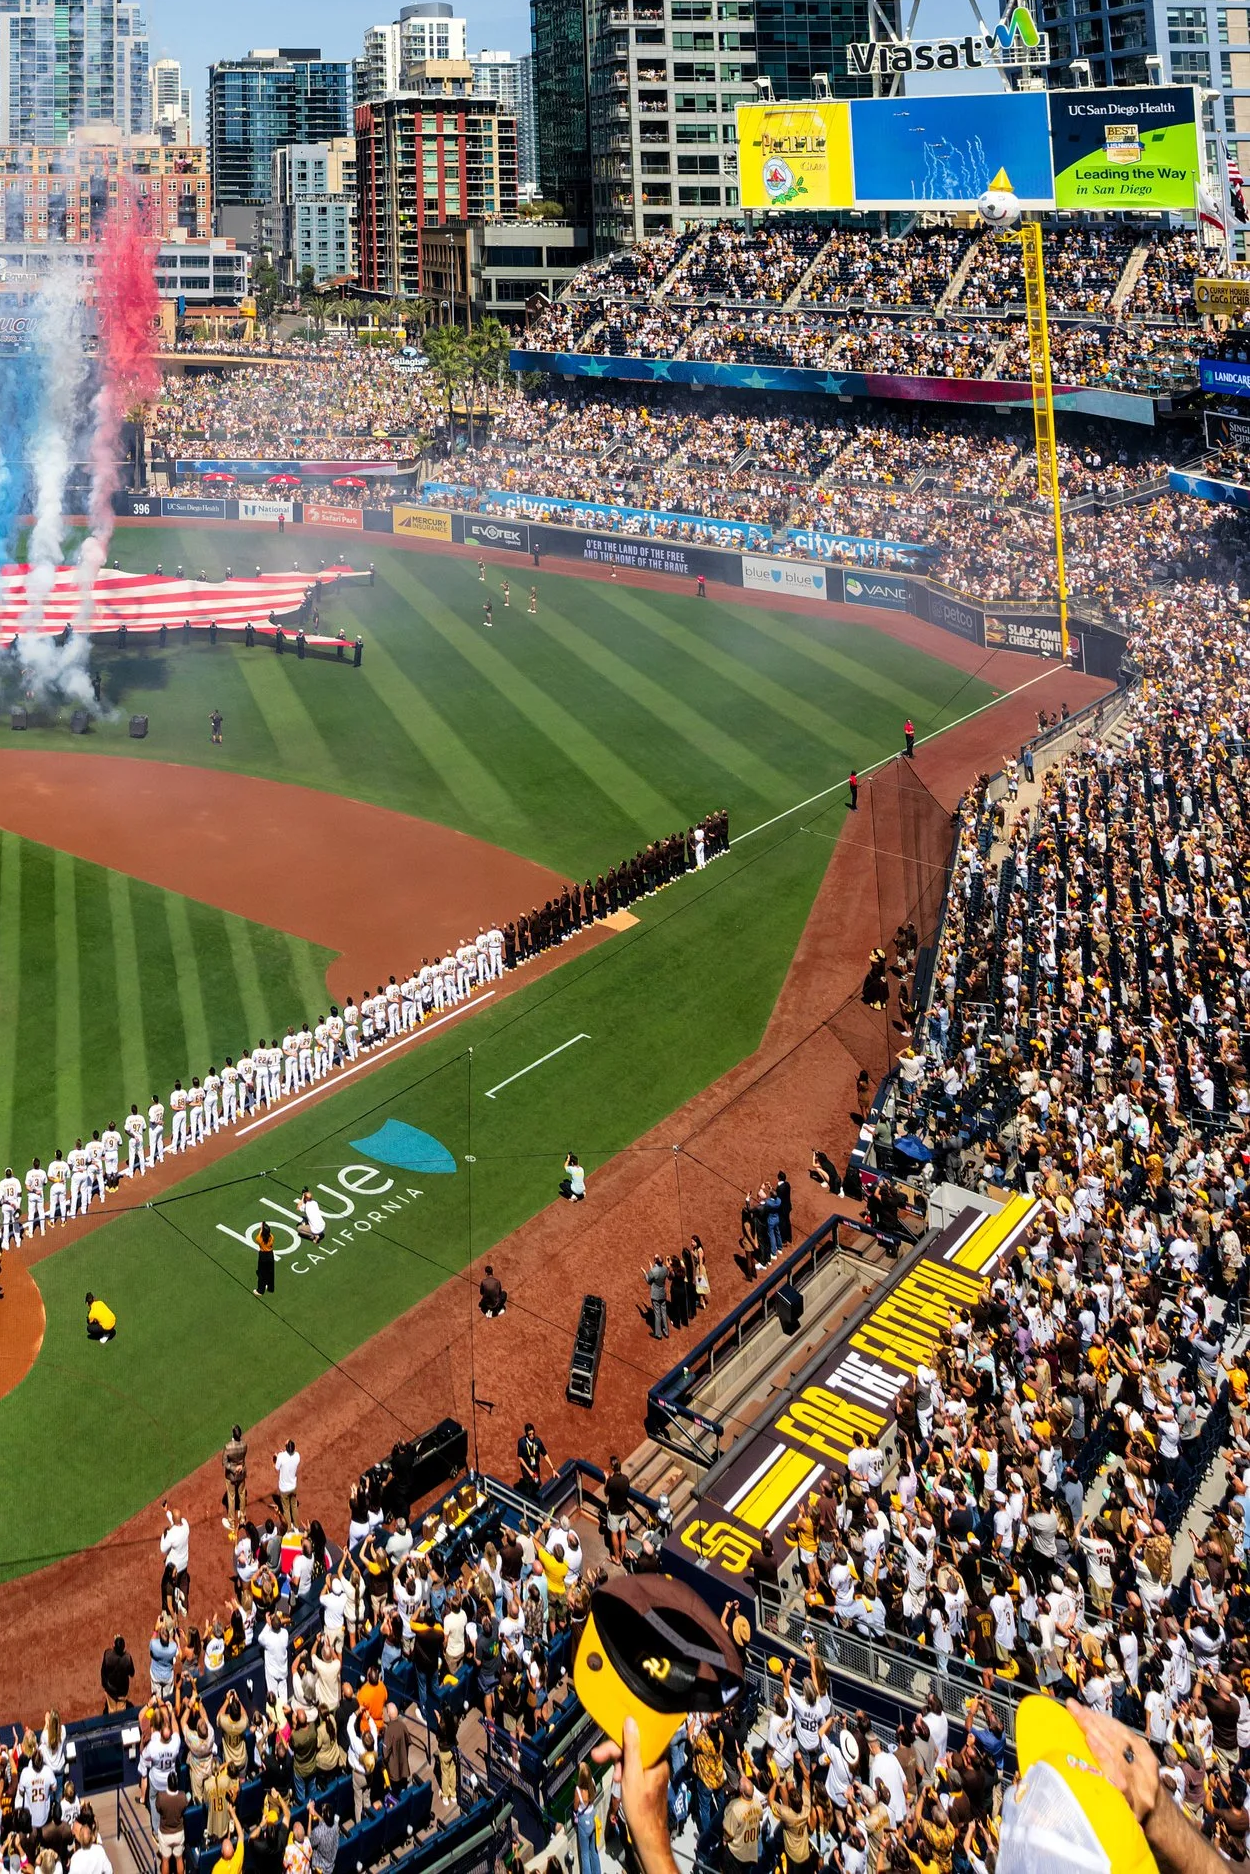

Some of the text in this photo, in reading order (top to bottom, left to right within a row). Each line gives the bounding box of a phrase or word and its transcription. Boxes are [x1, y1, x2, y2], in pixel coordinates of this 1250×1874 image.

[851, 37, 982, 74] Viasat
[1068, 102, 1176, 116] UC San Diego Health
[1106, 126, 1136, 136] BEST
[1075, 167, 1187, 182] Leading the Way
[1076, 184, 1152, 196] in San Diego
[1209, 286, 1250, 297] CURRY HOUSE
[1210, 294, 1229, 304] CoCo
[393, 364, 424, 374] Square
[133, 503, 150, 515] 396
[167, 502, 176, 510] UC
[177, 503, 187, 511] San
[202, 504, 220, 512] Health
[258, 505, 290, 513] National
[321, 514, 358, 525] Safari Park
[412, 515, 448, 527] MERCURY
[411, 523, 448, 534] INSURANCE
[471, 525, 521, 541] EVOTEK
[586, 538, 685, 563] O'ER THE LAND OF THE FREE
[583, 549, 689, 574] AND HOME OF THE BRAVE
[745, 566, 812, 585] blue blue
[943, 604, 973, 628] petco
[1007, 623, 1033, 638] SLAP
[1008, 634, 1040, 649] CHEESE
[1041, 640, 1054, 652] ON
[331, 1022, 339, 1030] 24
[258, 1056, 266, 1064] 22
[75, 1158, 85, 1168] 30
[6, 1187, 15, 1197] 13
[215, 1164, 395, 1262] blue
[290, 1186, 425, 1274] CALIFORNIA
[774, 1258, 991, 1466] FOR THE FAITHFUL
[31, 1787, 46, 1803] 25
